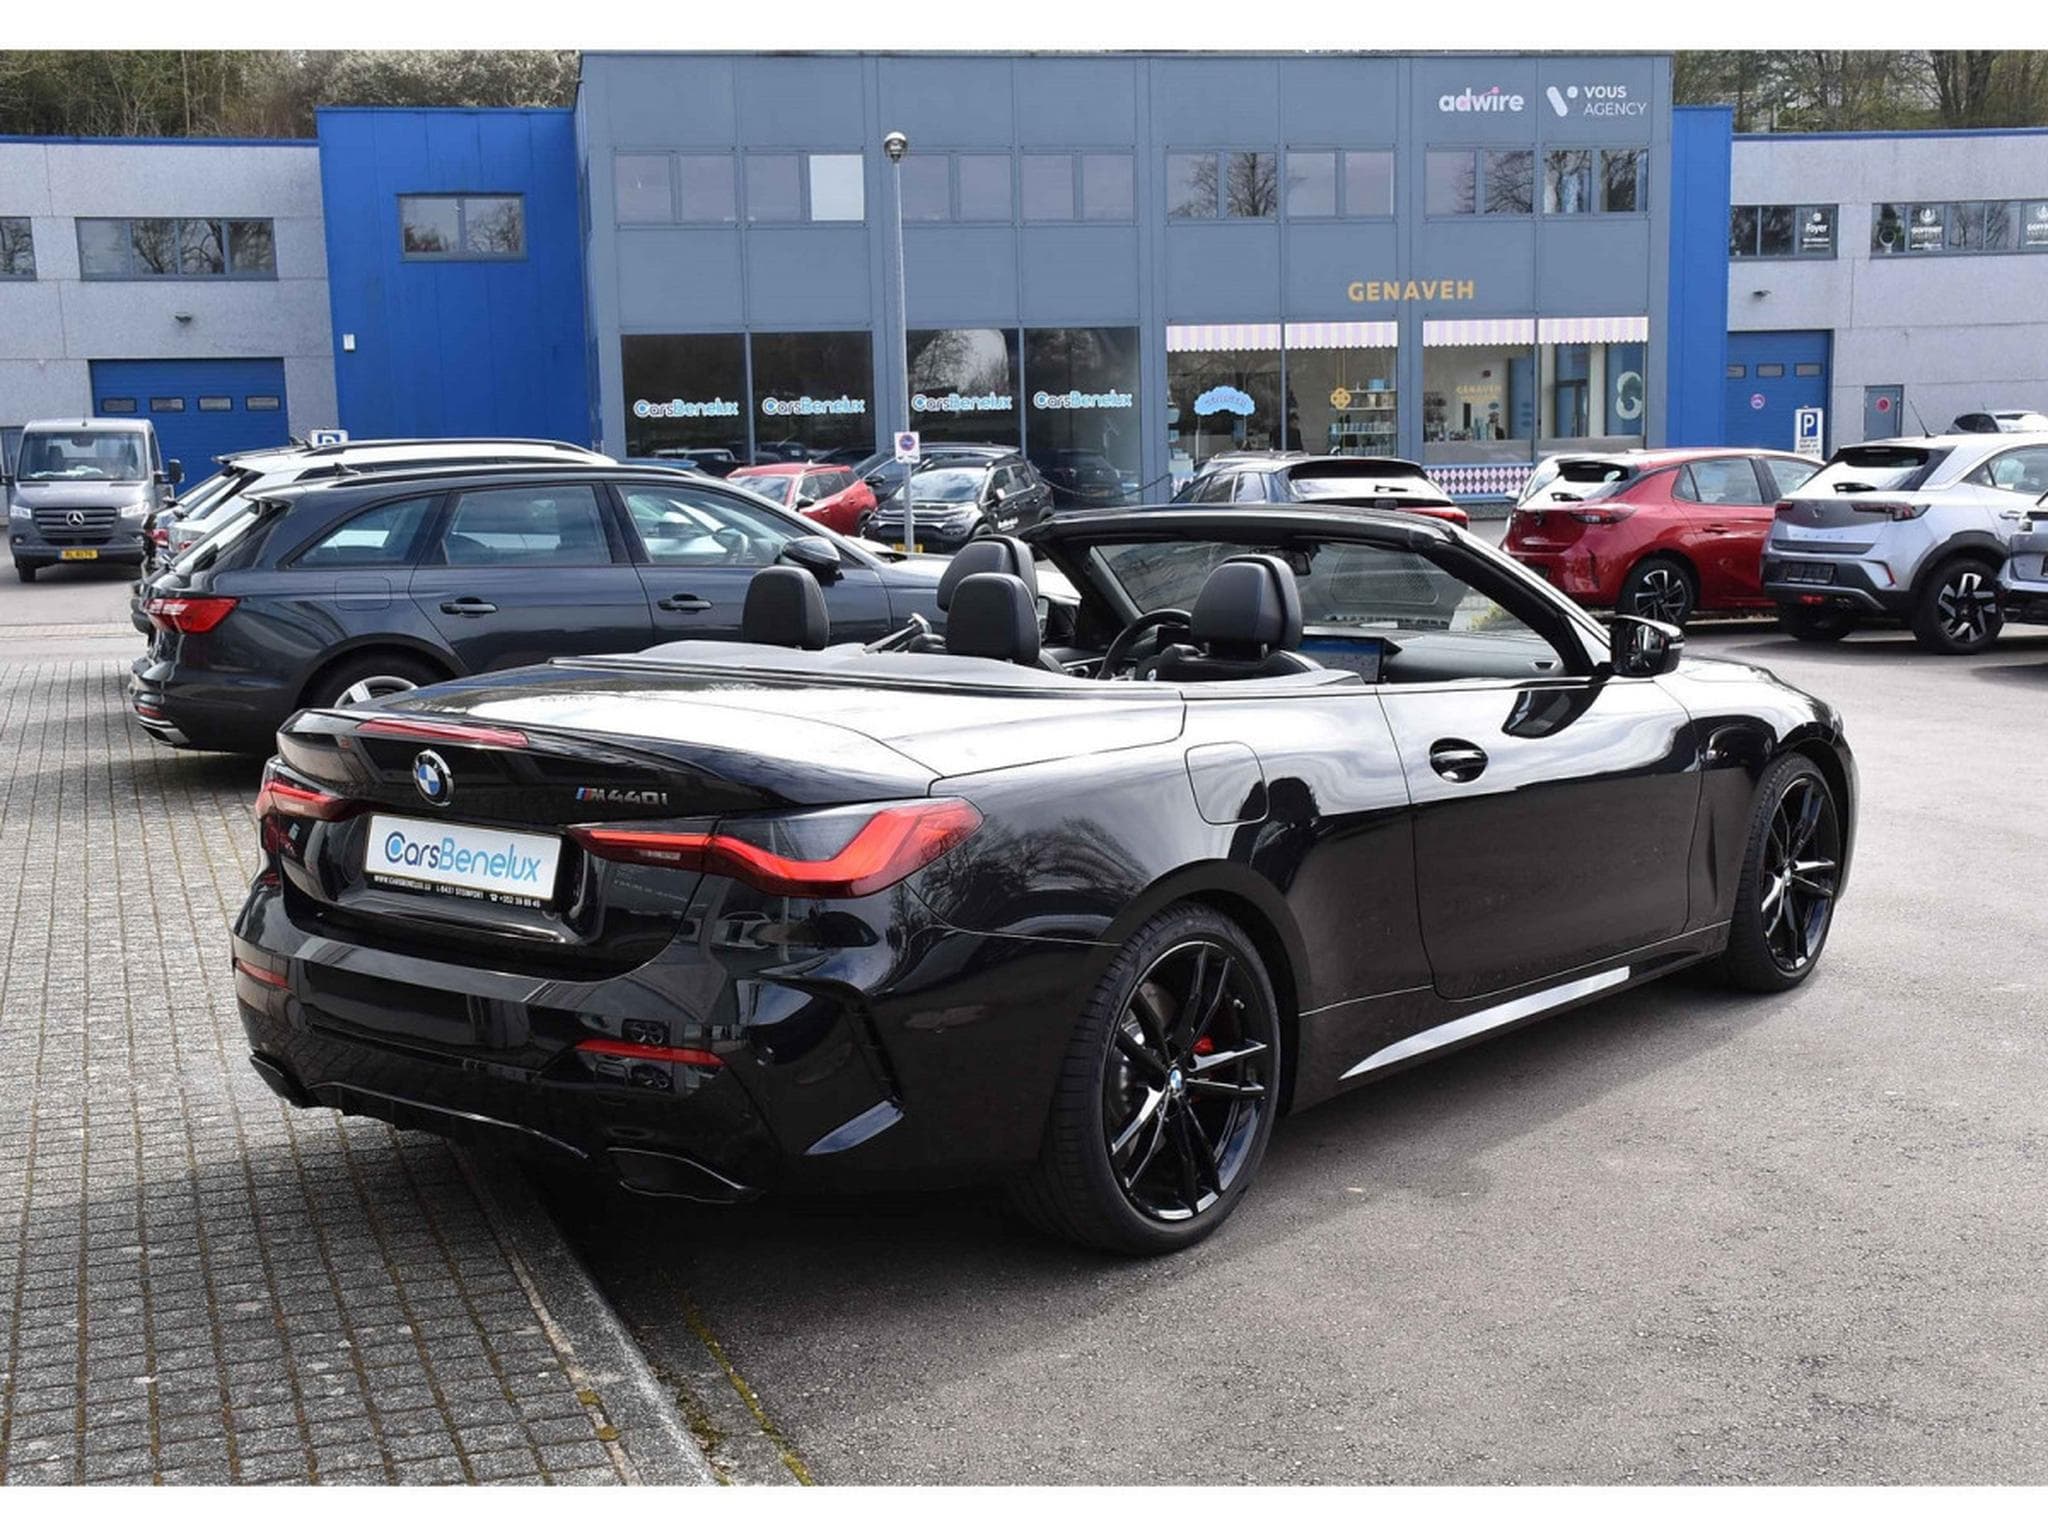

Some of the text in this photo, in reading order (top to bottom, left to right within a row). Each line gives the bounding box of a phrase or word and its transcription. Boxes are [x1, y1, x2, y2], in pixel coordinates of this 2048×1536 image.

[1438, 86, 1525, 112] adwire
[1583, 85, 1628, 99] VOUS
[1583, 102, 1648, 116] AGENCY
[1347, 280, 1475, 302] GENAVEH
[633, 397, 739, 418] CarsBenelux
[761, 395, 866, 416] CarsBenelux
[911, 392, 1013, 412] CarsBenelux
[1032, 389, 1133, 410] CarsBenelux
[1803, 413, 1816, 436] P
[384, 831, 543, 883] CarsBenelux
